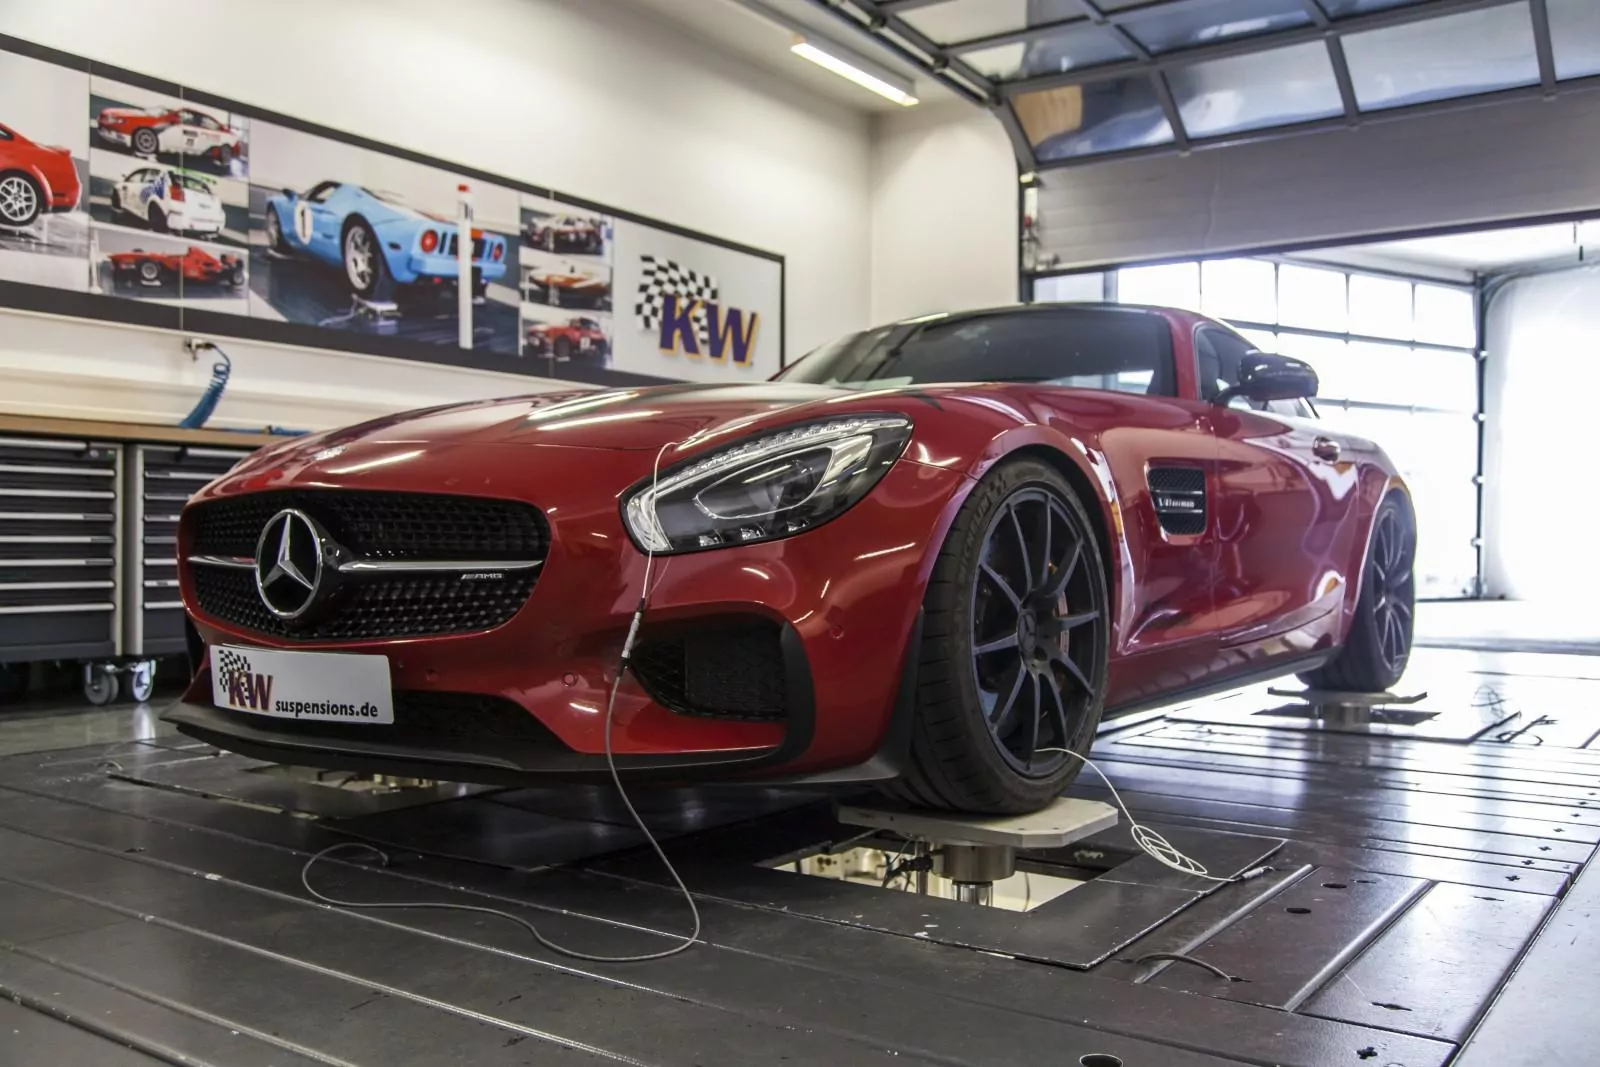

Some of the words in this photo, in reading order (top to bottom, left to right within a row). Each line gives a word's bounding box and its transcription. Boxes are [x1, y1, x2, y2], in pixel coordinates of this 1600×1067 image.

[659, 292, 760, 368] KW
[228, 669, 273, 712] KW
[275, 700, 378, 718] suspensions.de
